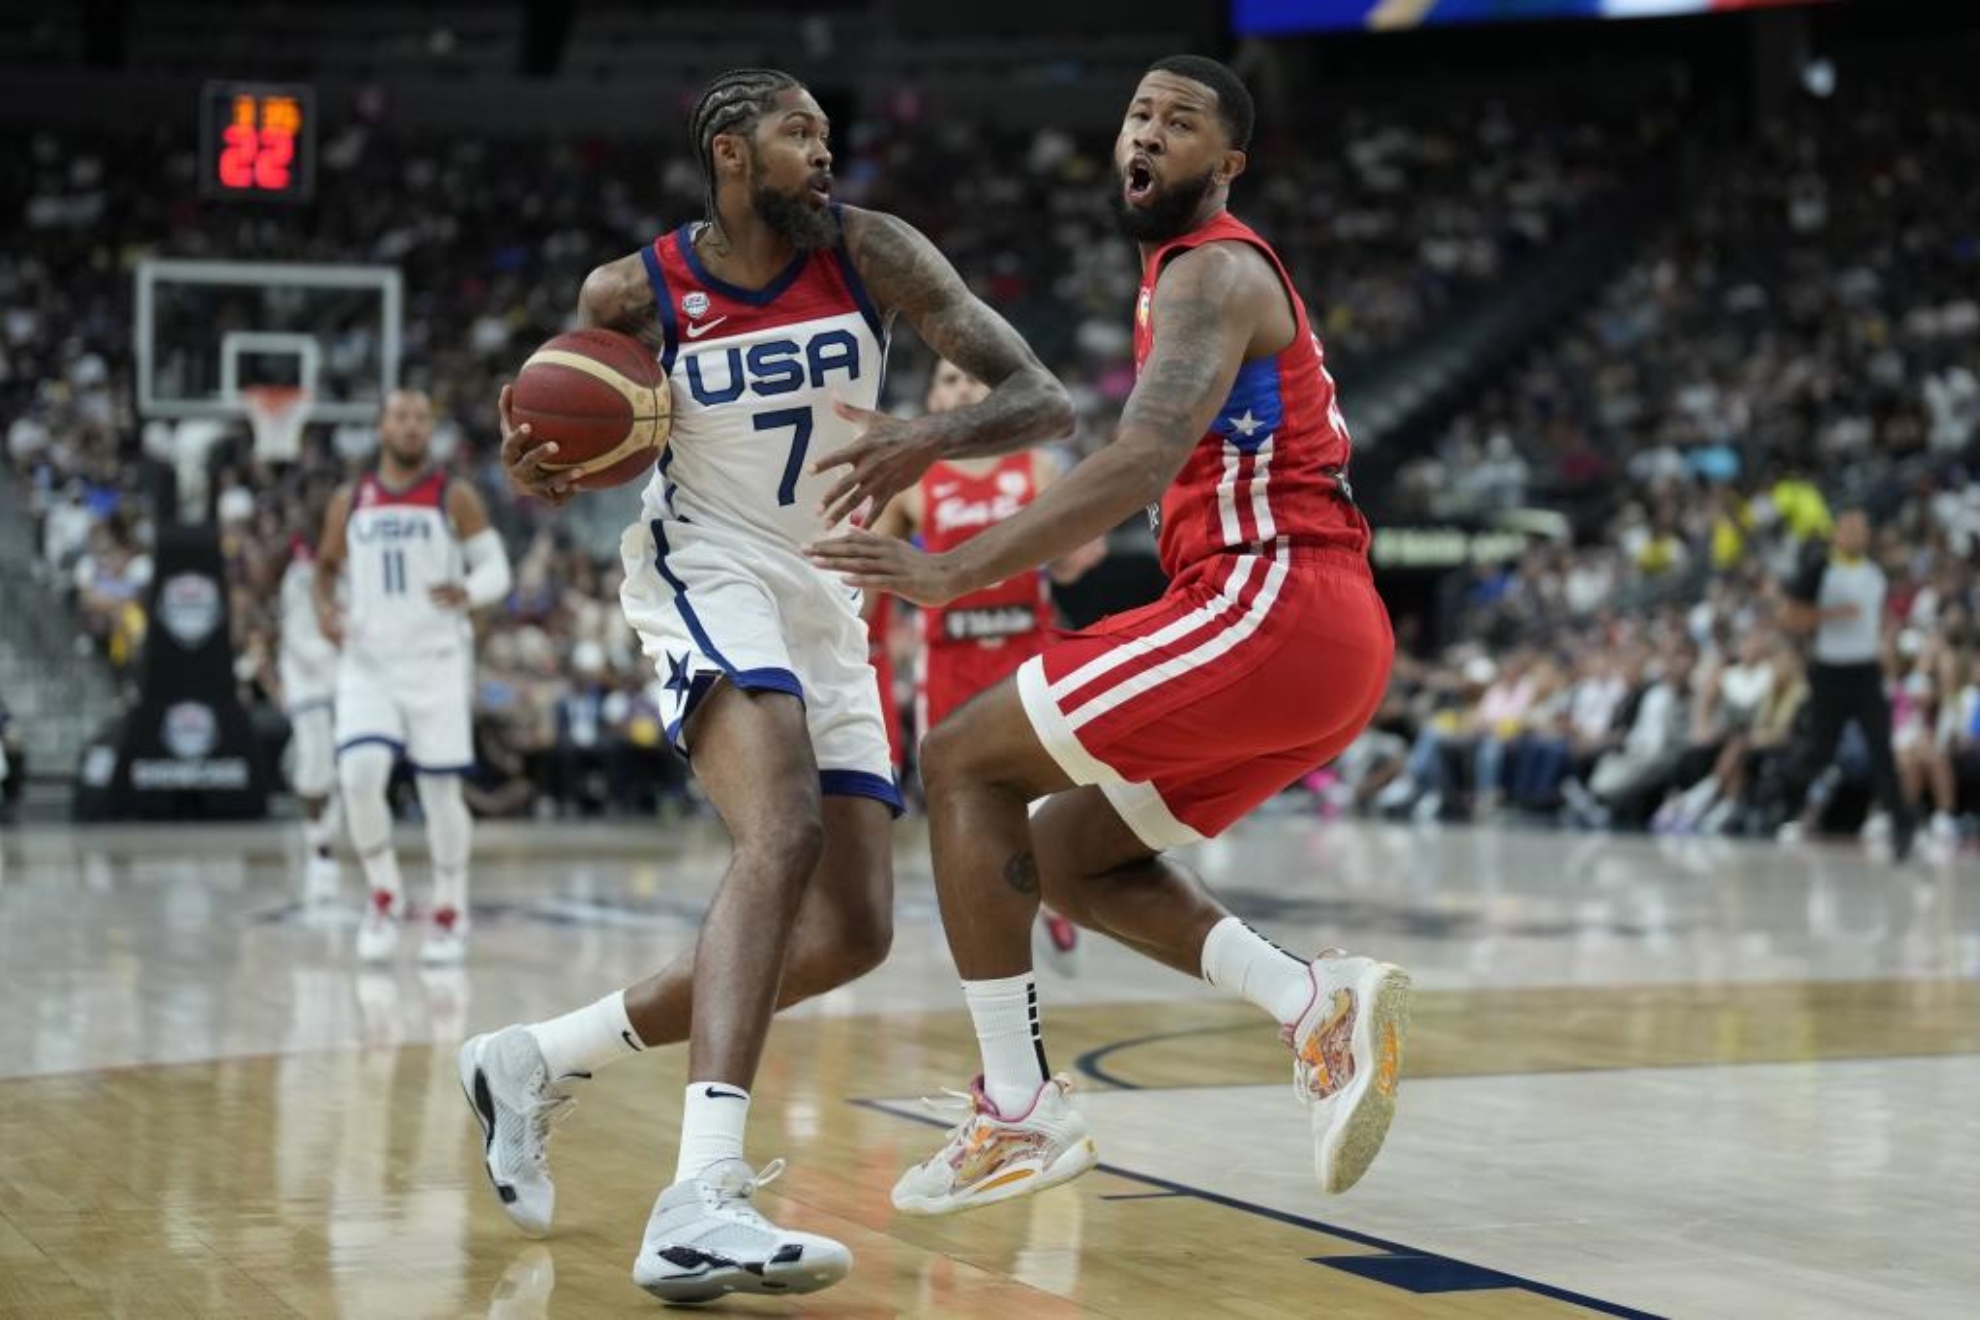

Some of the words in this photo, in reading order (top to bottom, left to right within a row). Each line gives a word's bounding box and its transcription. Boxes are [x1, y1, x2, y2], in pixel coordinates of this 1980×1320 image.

[685, 329, 860, 406] USA
[752, 405, 814, 507] 7
[354, 518, 431, 544] USA
[382, 550, 407, 594] 11
